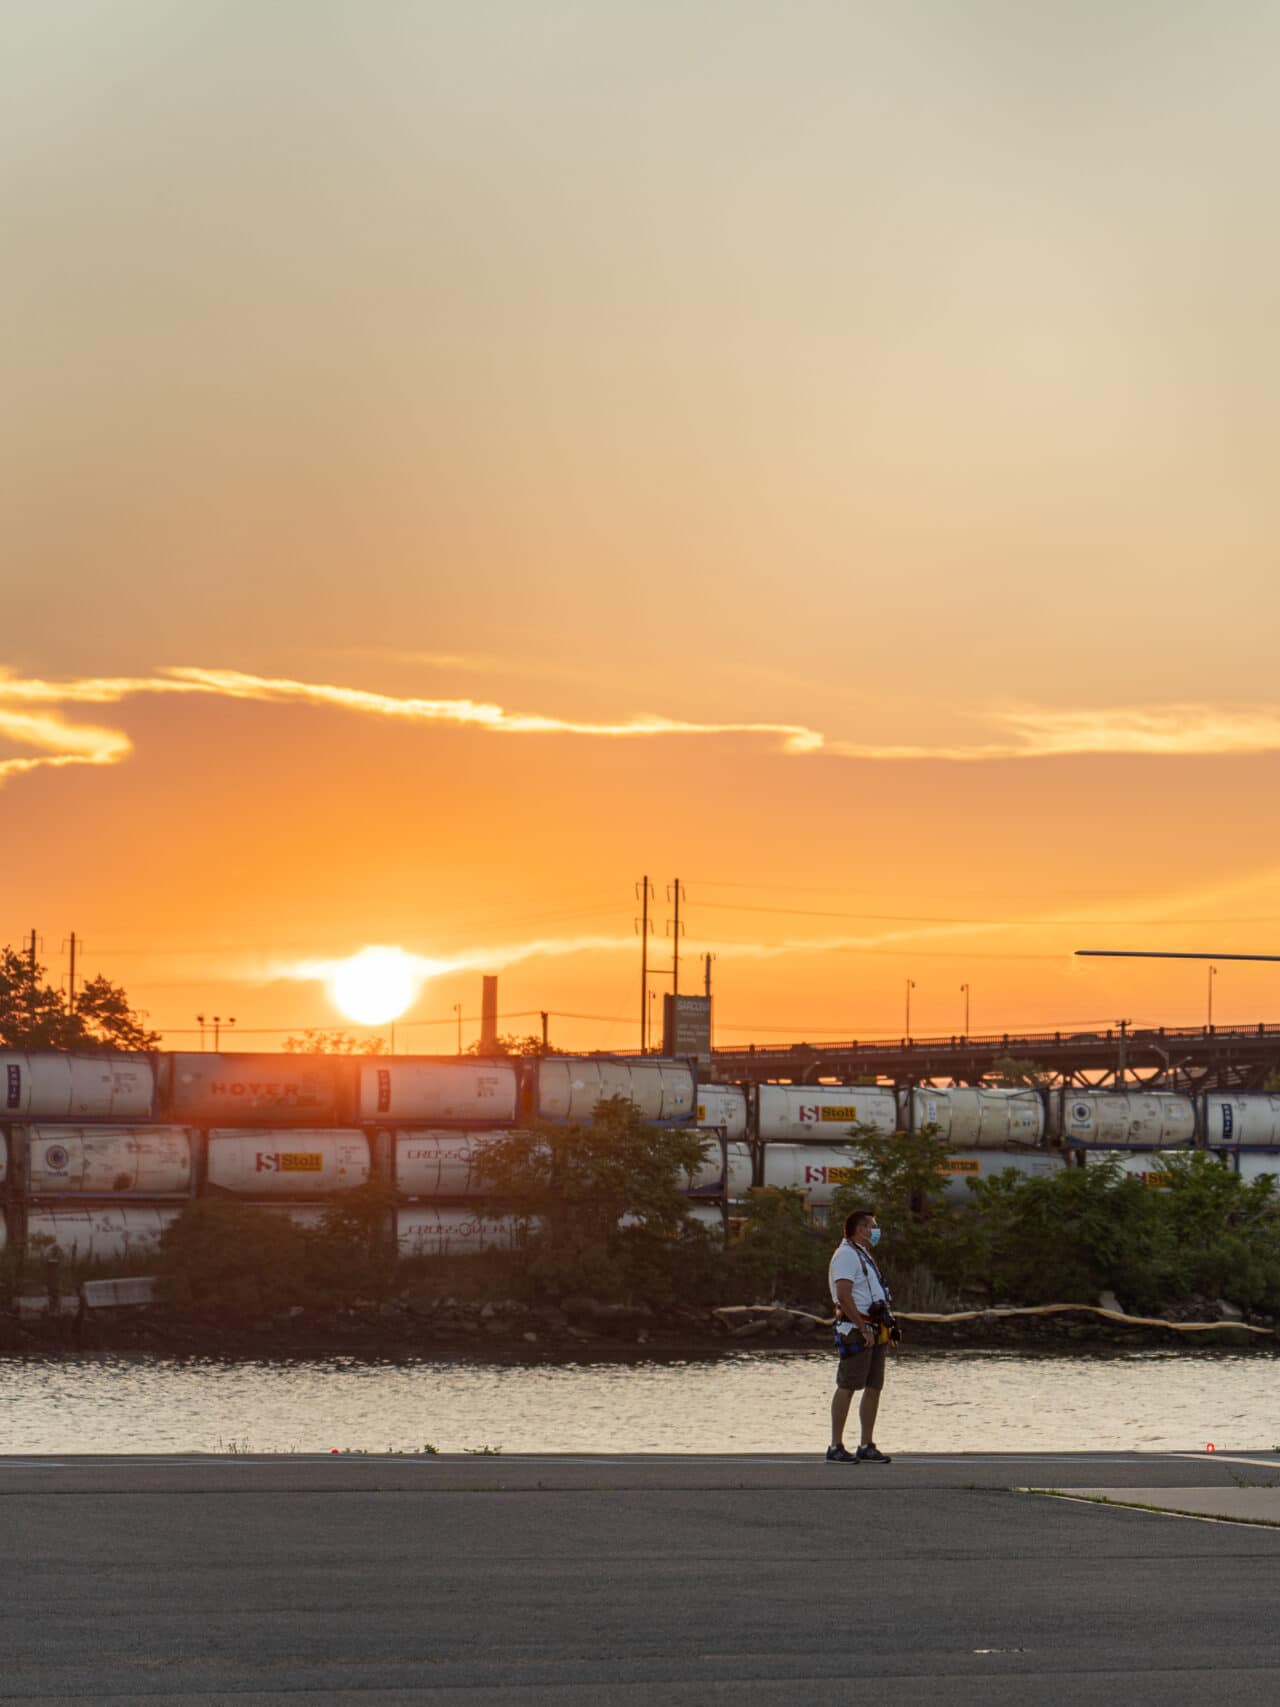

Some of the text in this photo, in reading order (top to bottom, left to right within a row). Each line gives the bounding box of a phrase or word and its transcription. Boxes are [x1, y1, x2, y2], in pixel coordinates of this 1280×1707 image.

[211, 1083, 299, 1096] HOYER
[822, 1107, 855, 1119] Stolt
[283, 1154, 322, 1170] Stolt
